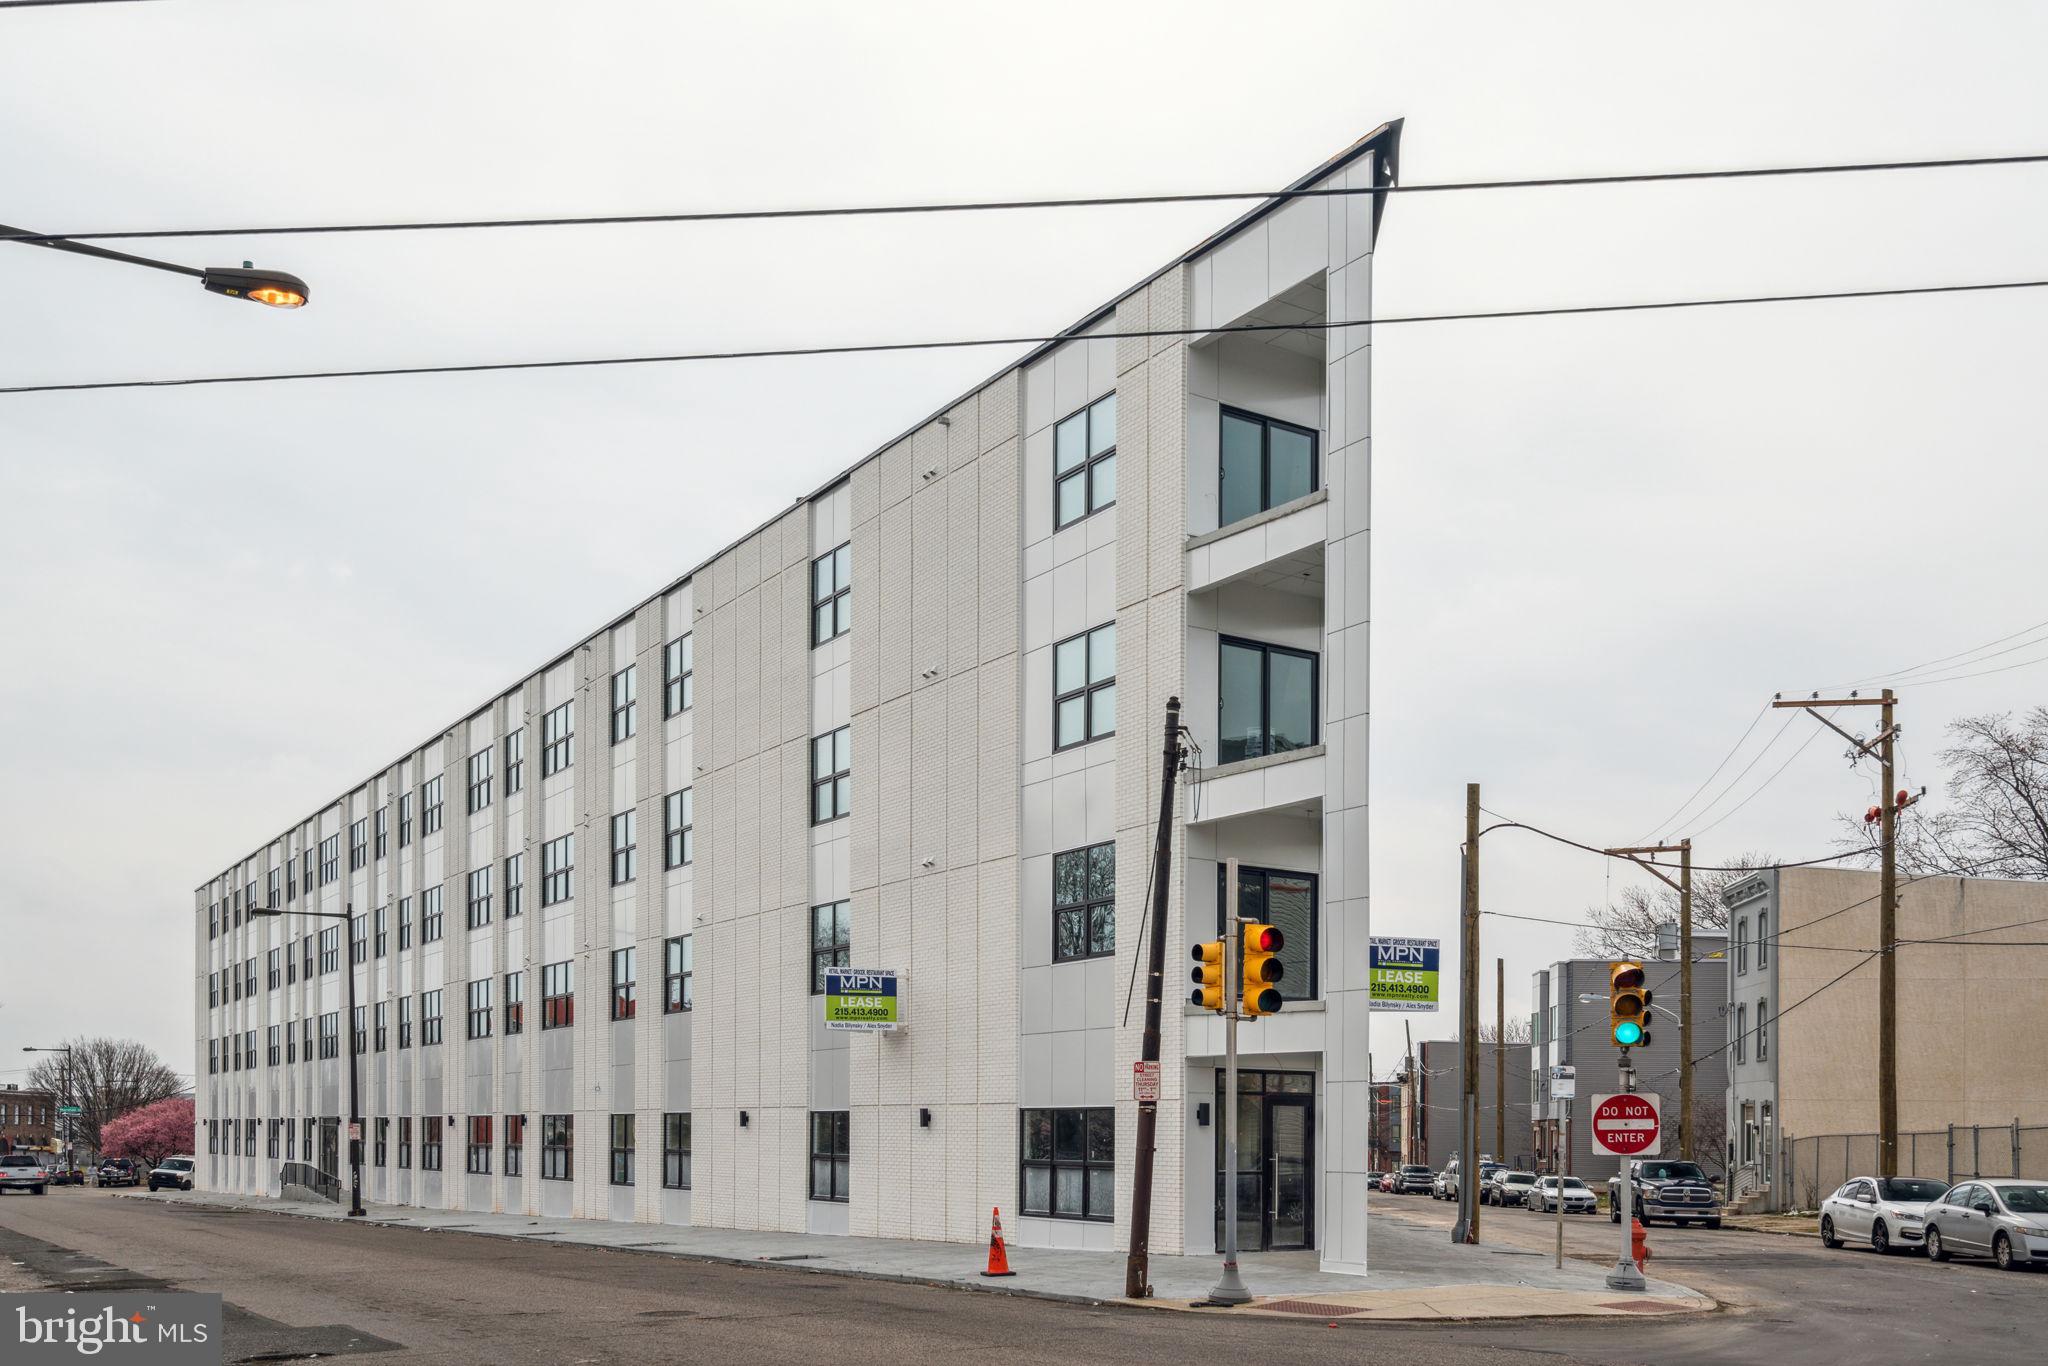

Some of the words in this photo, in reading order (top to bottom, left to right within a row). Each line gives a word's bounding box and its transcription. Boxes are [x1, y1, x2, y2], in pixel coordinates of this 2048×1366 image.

[1378, 946, 1423, 961] MPN
[840, 976, 882, 989] MPN
[1377, 970, 1424, 984] LEASE
[1370, 983, 1429, 994] 215.413.4900
[840, 997, 883, 1008] LEASE
[834, 1008, 889, 1017] 215.413.4900
[1135, 1063, 1144, 1072] NO
[1602, 1106, 1618, 1116] DO
[1625, 1106, 1649, 1116] NOT
[1607, 1133, 1645, 1143] ENTER
